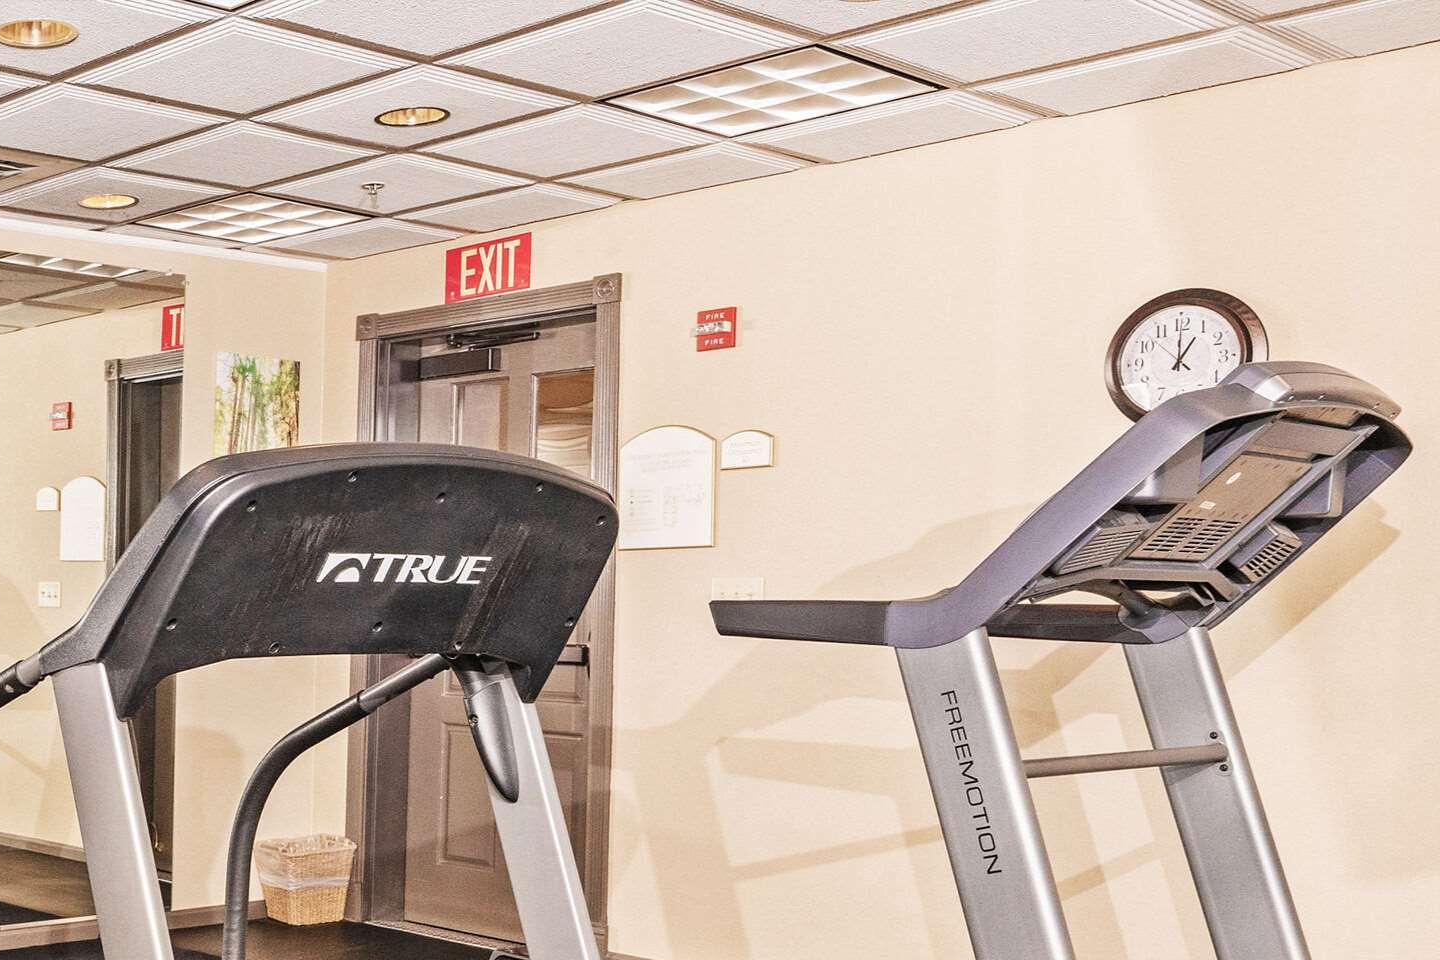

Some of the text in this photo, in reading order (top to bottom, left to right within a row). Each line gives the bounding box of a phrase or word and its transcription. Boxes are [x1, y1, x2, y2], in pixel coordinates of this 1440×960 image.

[460, 239, 521, 296] EXIT
[705, 312, 726, 320] FIRE
[1156, 324, 1167, 338] 11
[1176, 317, 1191, 332] 12
[1201, 319, 1206, 333] 1
[704, 338, 725, 346] FIRE
[1213, 331, 1224, 346] 2
[1140, 340, 1155, 354] 10
[1218, 349, 1229, 362] 3
[1134, 358, 1144, 372] 9
[372, 553, 492, 585] TRUE
[941, 690, 1002, 875] FREEMOTION
